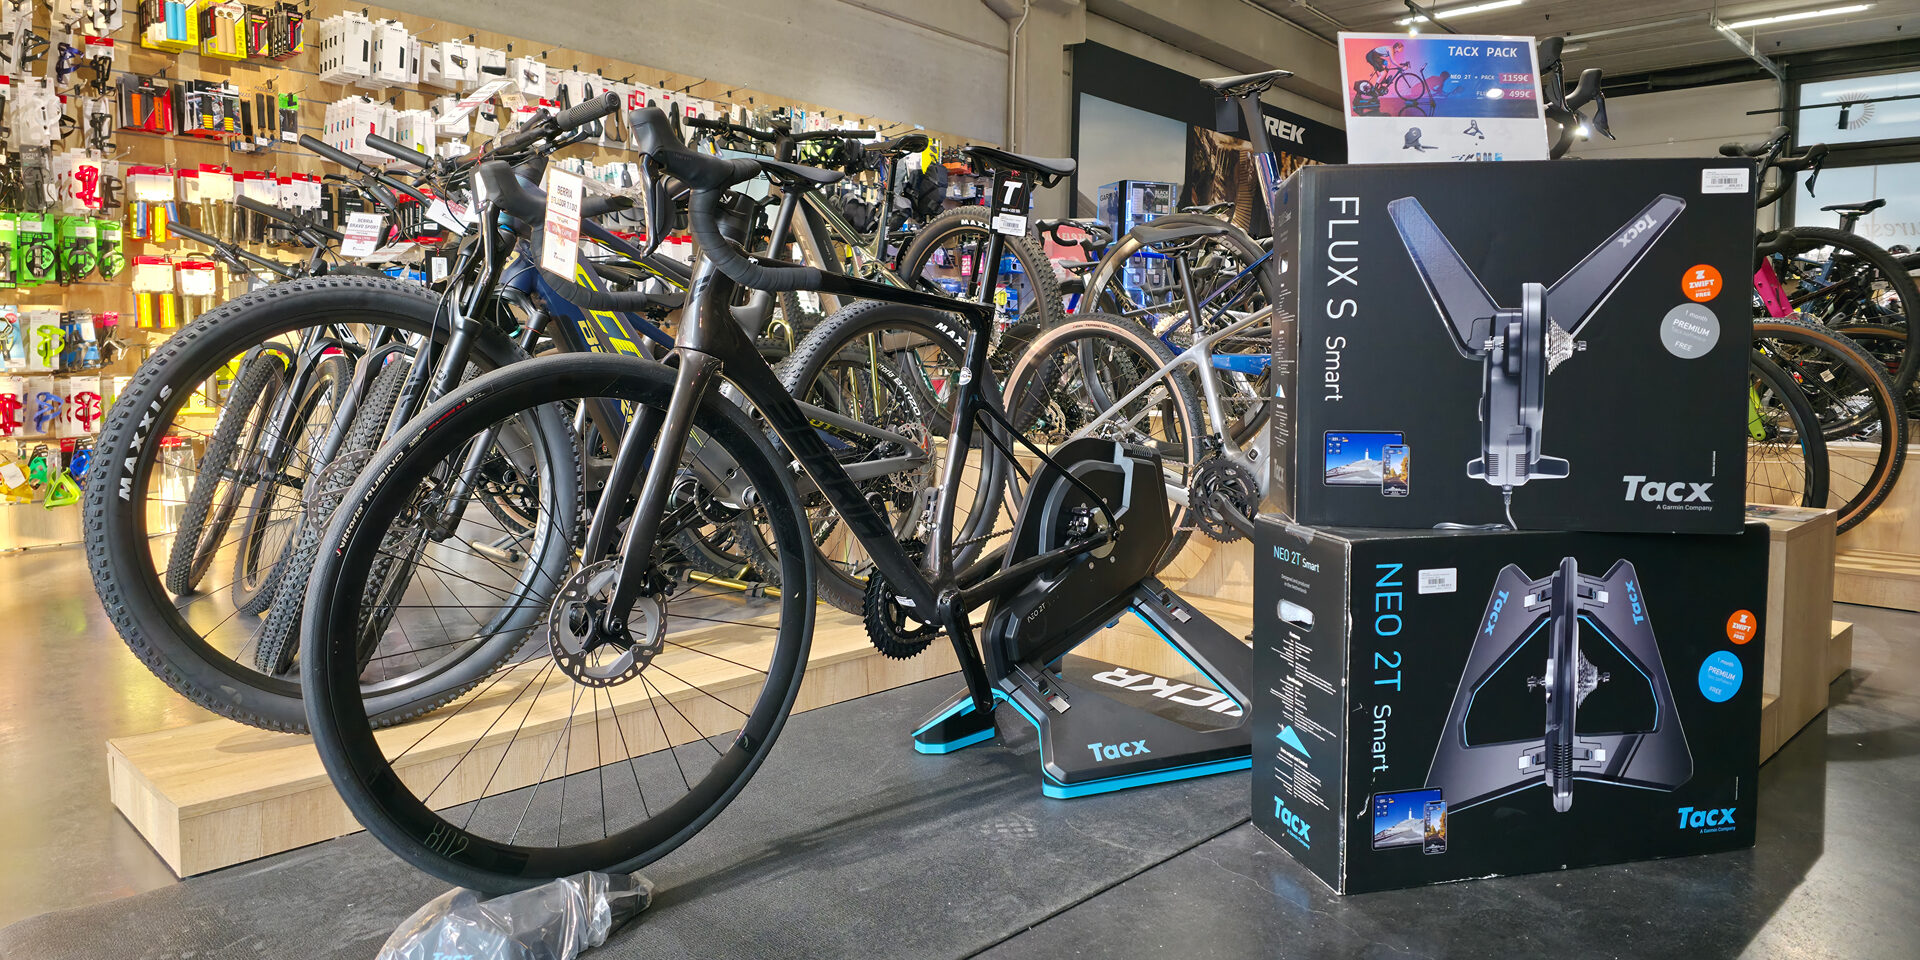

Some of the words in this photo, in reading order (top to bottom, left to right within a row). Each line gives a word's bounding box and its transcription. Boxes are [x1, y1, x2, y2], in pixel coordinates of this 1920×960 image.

[1448, 46, 1479, 57] TACX
[1486, 47, 1518, 58] PACK
[1262, 114, 1306, 145] REK
[1327, 196, 1360, 286] FLUX
[1617, 214, 1658, 248] Tacx
[1688, 279, 1715, 288] ZWIFT
[1326, 298, 1358, 319] S
[1672, 318, 1711, 336] PREMIUM
[1674, 340, 1694, 352] FREE
[1324, 336, 1346, 402] Smart
[894, 378, 920, 416] BARZO
[119, 383, 173, 501] MAXXIS
[338, 504, 364, 549] vittoria
[364, 451, 404, 502] RUBINO
[1622, 475, 1714, 502] Tacx
[1273, 545, 1290, 562] NEO
[1291, 551, 1302, 566] 2T
[1302, 558, 1320, 572] Smart
[1375, 563, 1404, 636] NEO
[1484, 589, 1510, 636] Tacx
[1624, 579, 1645, 626] Tacx
[1732, 622, 1752, 632] ZWIFT
[1374, 651, 1402, 692] 2T
[1708, 665, 1736, 680] PREMIUM
[1088, 740, 1151, 762] Tacx
[1372, 704, 1392, 772] Smart
[1274, 795, 1311, 842] Tacx
[1678, 806, 1736, 829] Tacx
